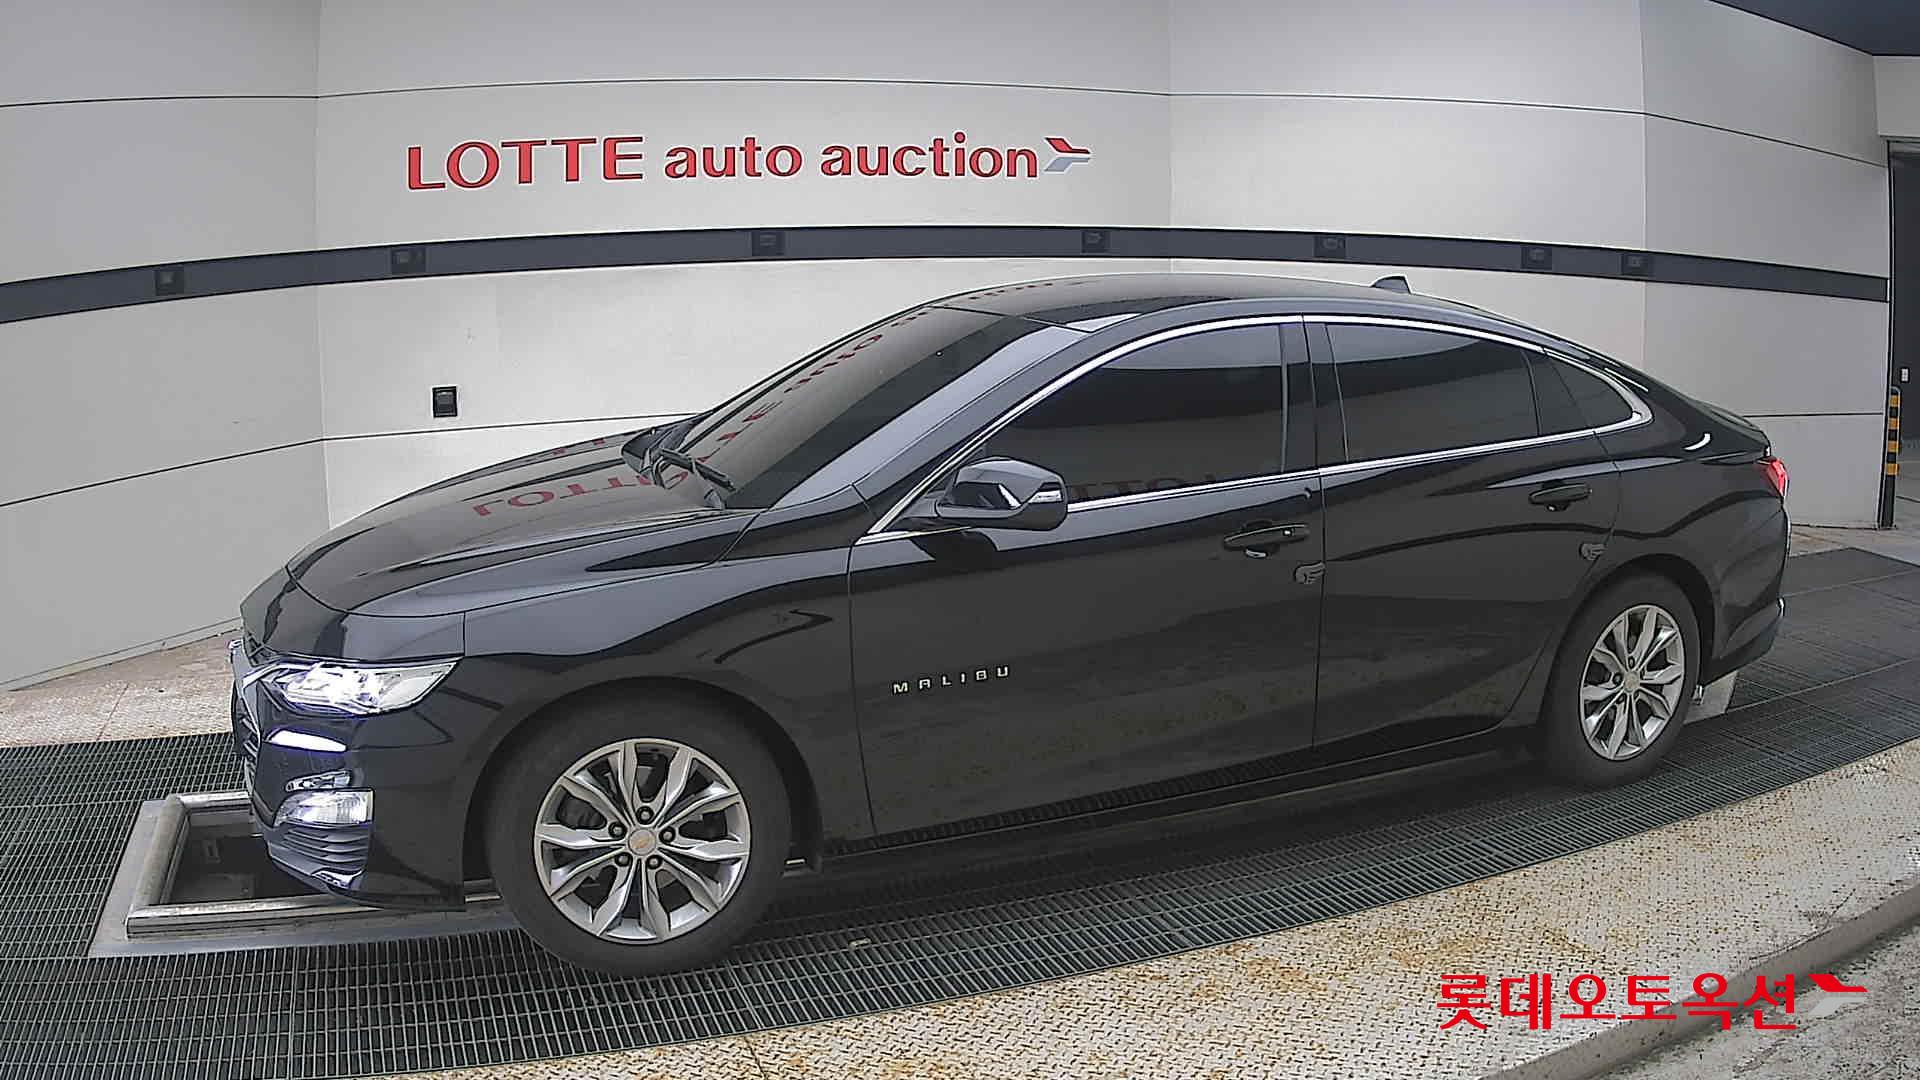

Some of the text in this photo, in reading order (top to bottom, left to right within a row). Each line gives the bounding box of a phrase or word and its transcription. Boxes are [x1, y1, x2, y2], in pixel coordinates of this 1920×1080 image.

[407, 131, 1038, 190] LOTTE auto auction
[892, 665, 1010, 695] MALIBU
